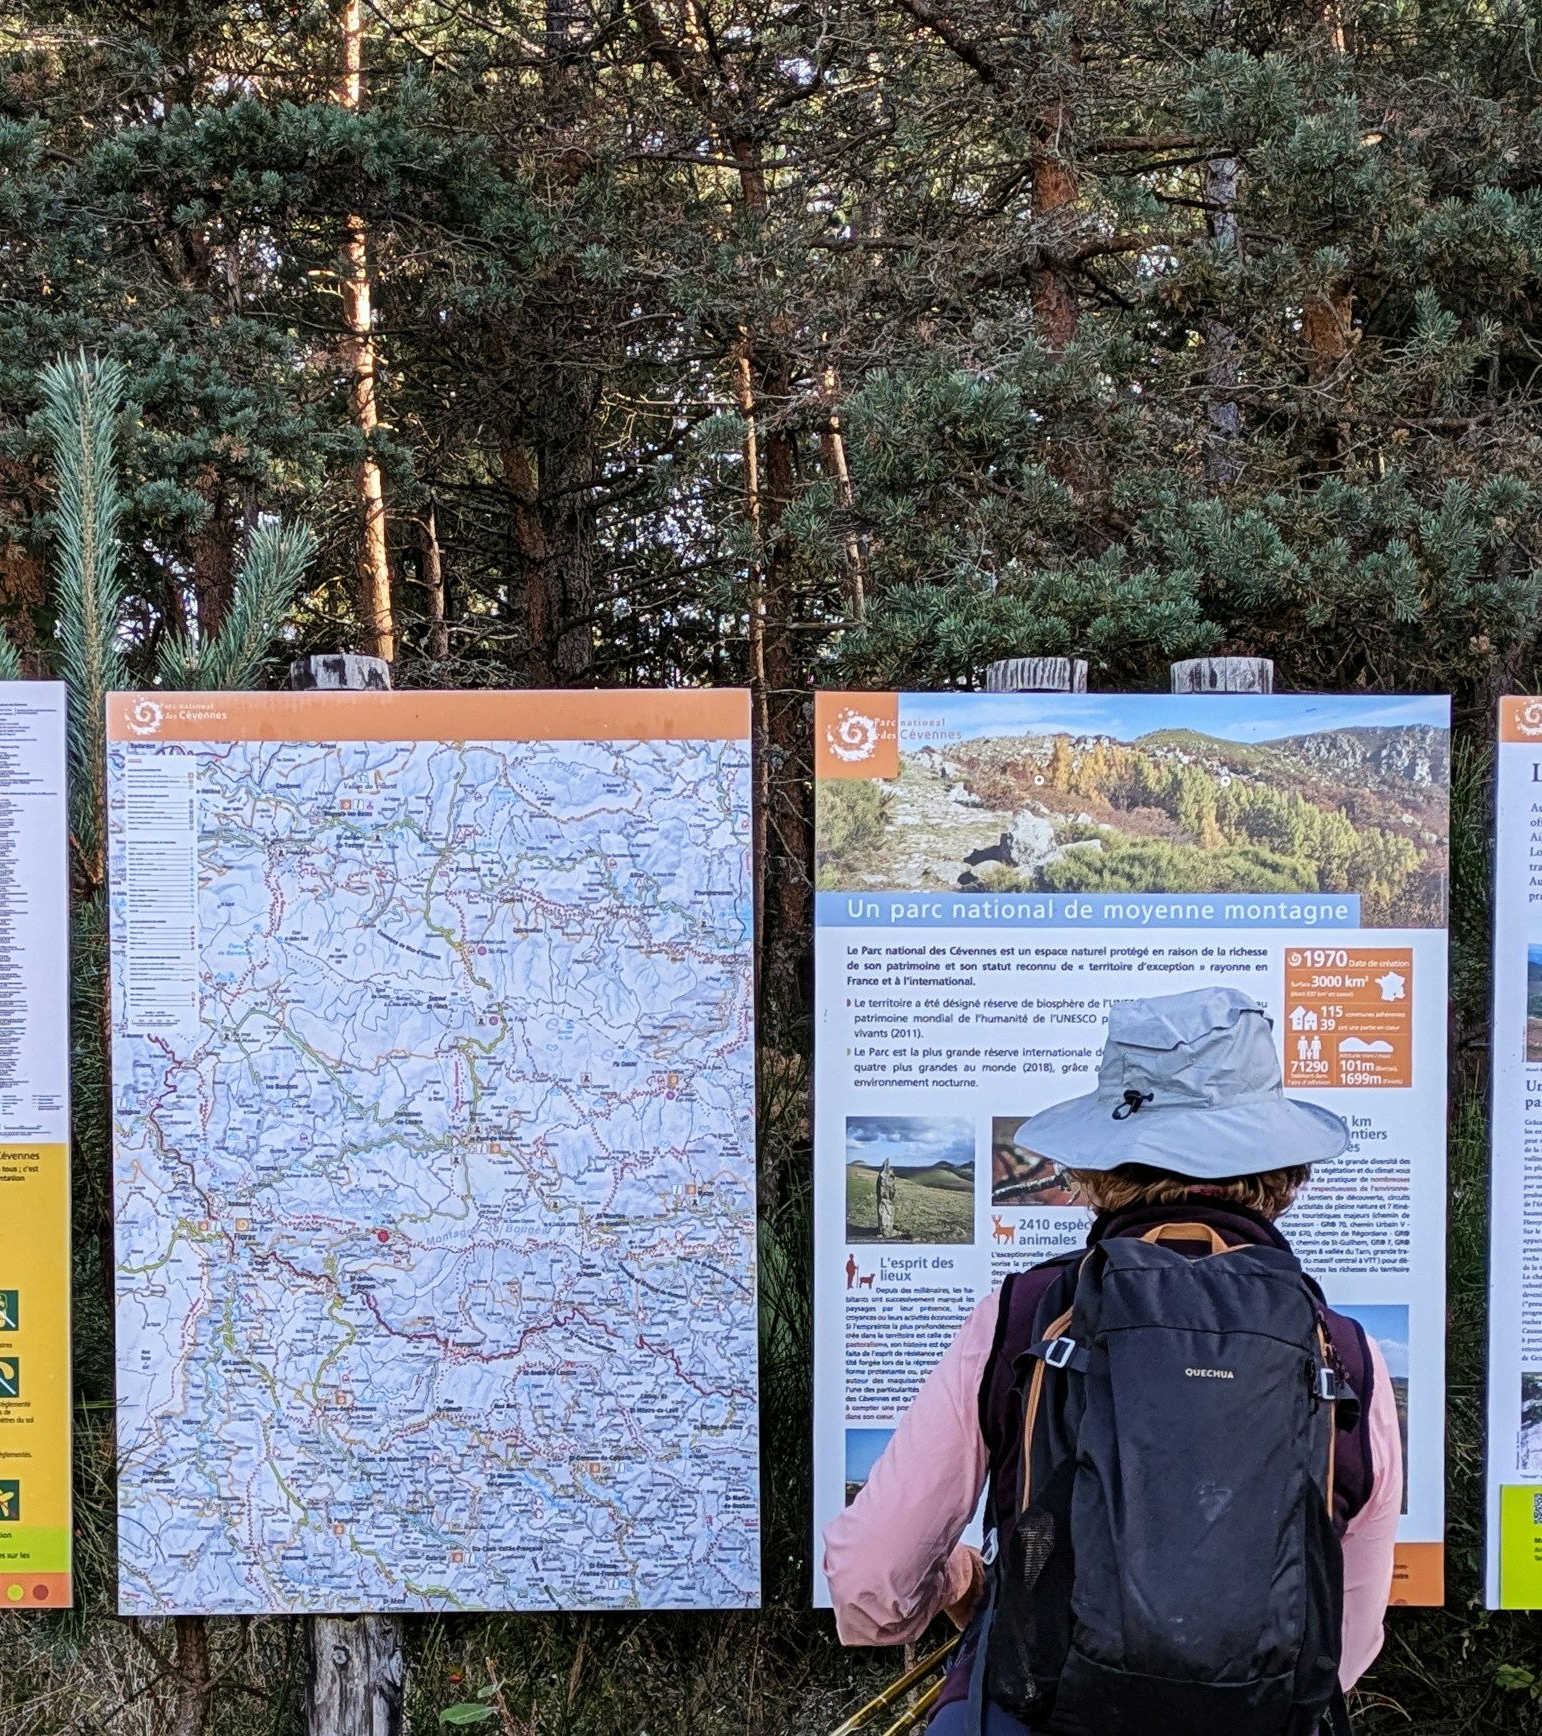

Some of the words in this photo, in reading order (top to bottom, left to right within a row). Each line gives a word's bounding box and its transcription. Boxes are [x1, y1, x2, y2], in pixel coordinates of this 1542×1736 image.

[179, 710, 228, 721] Cévennes
[873, 717, 897, 727] Parc
[900, 717, 946, 727] national
[880, 730, 897, 740] des
[900, 727, 963, 740] Cévennes
[847, 899, 881, 919] Un
[889, 903, 942, 925] parc
[951, 898, 1054, 920] national
[1063, 898, 1093, 919] de
[1104, 902, 1214, 925] moyenne
[1225, 900, 1348, 926] montagne
[846, 946, 858, 955] Le
[861, 945, 882, 955] Parc
[885, 945, 926, 955] national
[929, 946, 946, 955] des
[949, 946, 997, 955] Cévennes
[1000, 947, 1015, 955] est
[1034, 948, 1068, 957] espace
[1071, 946, 1106, 955] naturel
[1109, 947, 1149, 958] protégé
[1151, 948, 1164, 956] en
[1168, 947, 1198, 956] raison
[1201, 947, 1214, 956] de
[1217, 946, 1226, 956] la
[1229, 947, 1267, 956] richesse
[1303, 950, 1348, 967] 1970
[1311, 975, 1342, 987] 3000
[1345, 975, 1369, 987] km²
[1320, 1005, 1343, 1017] 115
[1320, 1019, 1336, 1030] 39
[853, 1028, 888, 1037] vivants
[890, 1028, 923, 1039] (2011).
[1290, 1061, 1329, 1072] 71290
[1339, 1060, 1375, 1072] 101m
[853, 1077, 929, 1087] environnement
[931, 1078, 978, 1087] nocturne.
[1340, 1073, 1382, 1085] 1699m
[1352, 1115, 1372, 1127] km
[1019, 1219, 1050, 1230] 2410
[1054, 1217, 1091, 1235] espèc
[234, 1233, 256, 1241] Florac
[1019, 1234, 1077, 1246] animales
[880, 1256, 927, 1273] L'esprit
[931, 1256, 954, 1268] des
[879, 1270, 912, 1281] lieux
[1185, 1368, 1234, 1379] QUECHUA
